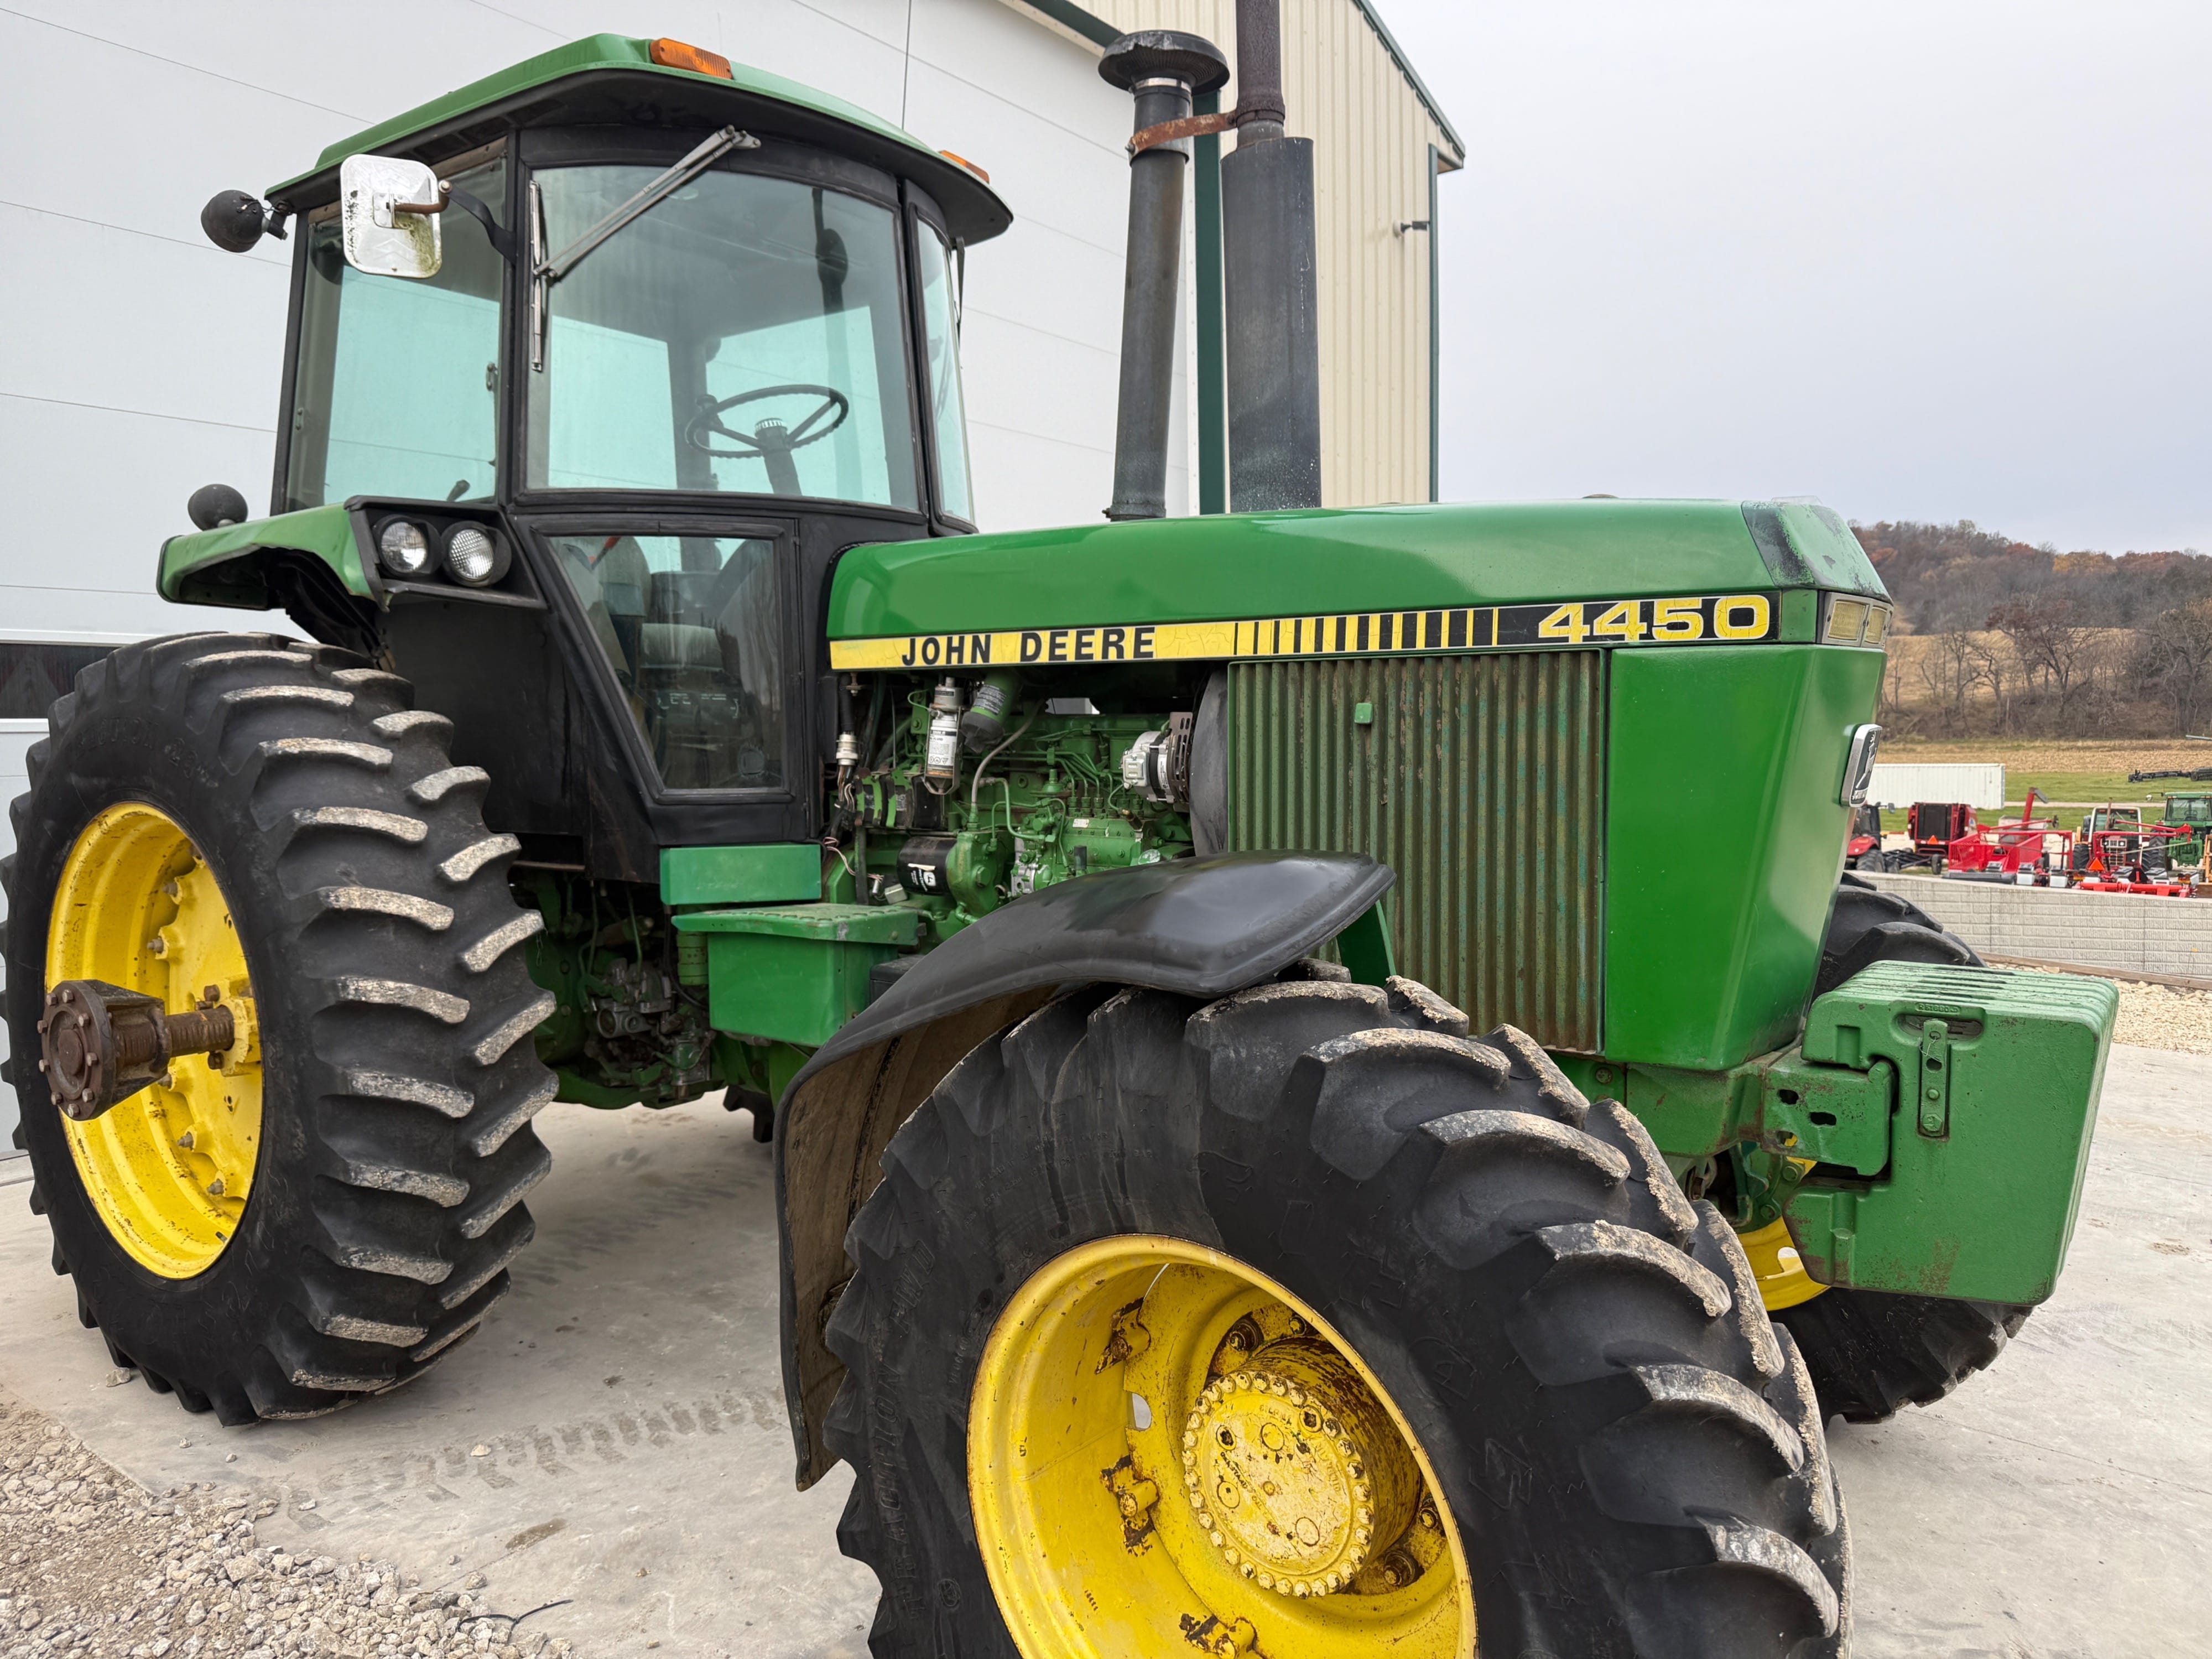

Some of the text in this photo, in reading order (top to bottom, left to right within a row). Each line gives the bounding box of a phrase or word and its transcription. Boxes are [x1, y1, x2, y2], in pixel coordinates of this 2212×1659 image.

[1538, 595, 1770, 643] 4450
[902, 627, 1155, 666] JOHN DEERE
